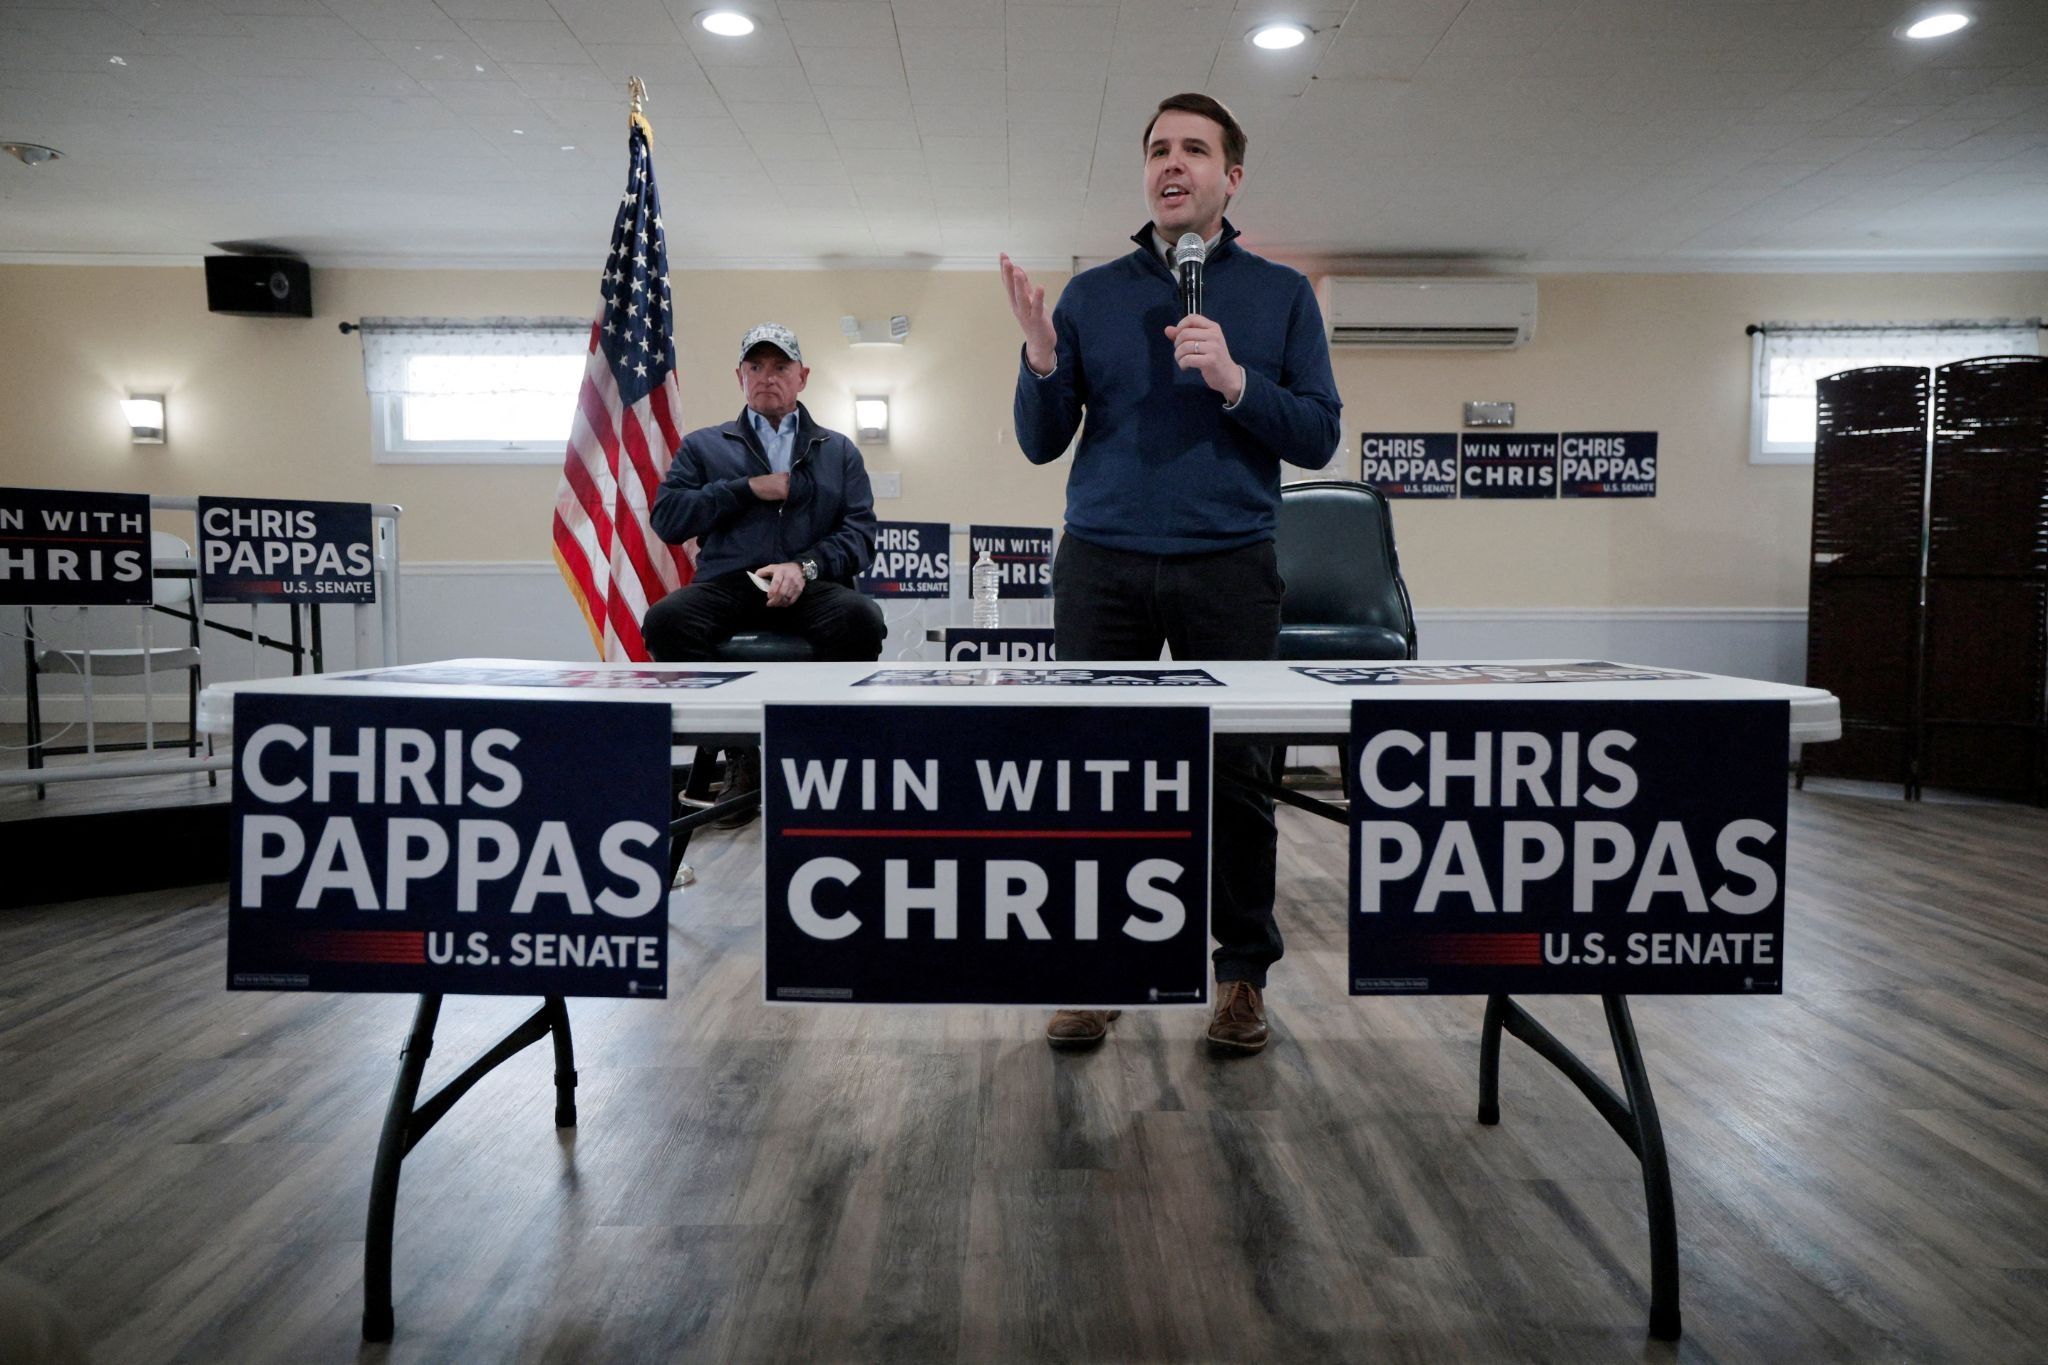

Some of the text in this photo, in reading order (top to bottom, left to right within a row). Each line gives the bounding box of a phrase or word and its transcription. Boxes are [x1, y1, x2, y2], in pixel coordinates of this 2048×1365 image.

[1363, 439, 1425, 458] CHRIS
[1464, 443, 1554, 457] WIN WITH
[1563, 438, 1625, 457] CHRIS
[1363, 459, 1456, 481] PAPPAS
[1465, 465, 1553, 486] CHRIS
[1563, 458, 1656, 480] PAPPAS
[1403, 484, 1456, 493] U.S. SENATE
[1603, 482, 1655, 493] U.S. SENATE
[41, 511, 142, 533] WITH
[203, 508, 316, 538] CHRIS
[874, 529, 920, 551] HRIS
[973, 538, 1052, 554] WIN WITH
[0, 548, 142, 581] HRIS
[205, 540, 371, 576] PAPPAS
[860, 552, 949, 579] APPAS
[997, 562, 1052, 585] HRIS
[283, 581, 372, 593] U.S. SENATE
[900, 583, 948, 591] U.S. SENATE
[950, 641, 1056, 662] CHRI
[242, 724, 522, 808] CHRIS
[1360, 730, 1638, 808] CHRIS
[781, 759, 1189, 811] WIN WITH
[241, 815, 661, 918] PAPPAS
[1360, 818, 1778, 915] PAPPAS
[788, 857, 1185, 941] CHRIS
[429, 932, 658, 968] U.S. SENATE
[1545, 933, 1773, 964] U.S. SENATE
